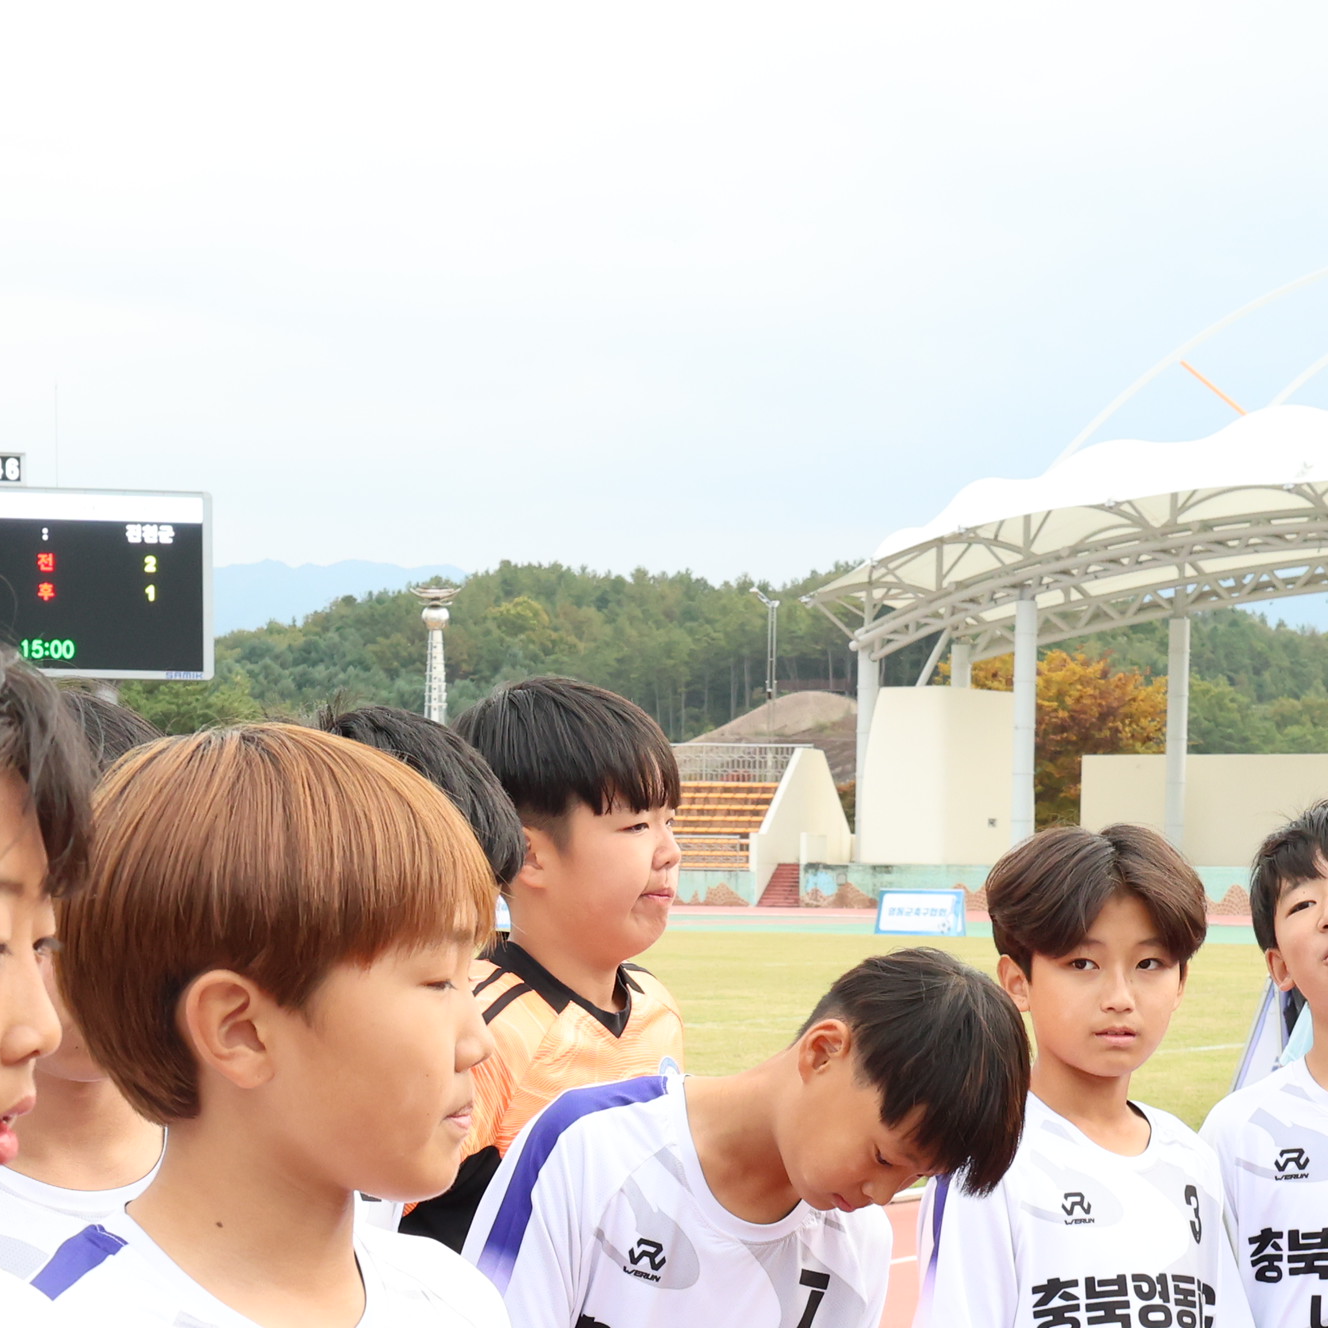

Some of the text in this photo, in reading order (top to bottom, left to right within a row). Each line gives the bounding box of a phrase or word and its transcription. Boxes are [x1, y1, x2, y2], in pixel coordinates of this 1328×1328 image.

[37, 553, 56, 571] 전
[144, 555, 157, 573] 2
[38, 582, 56, 602] 후
[144, 584, 156, 602] 1
[21, 638, 75, 660] 15:00
[1184, 1184, 1202, 1244] 3
[623, 1265, 661, 1283] WERUN
